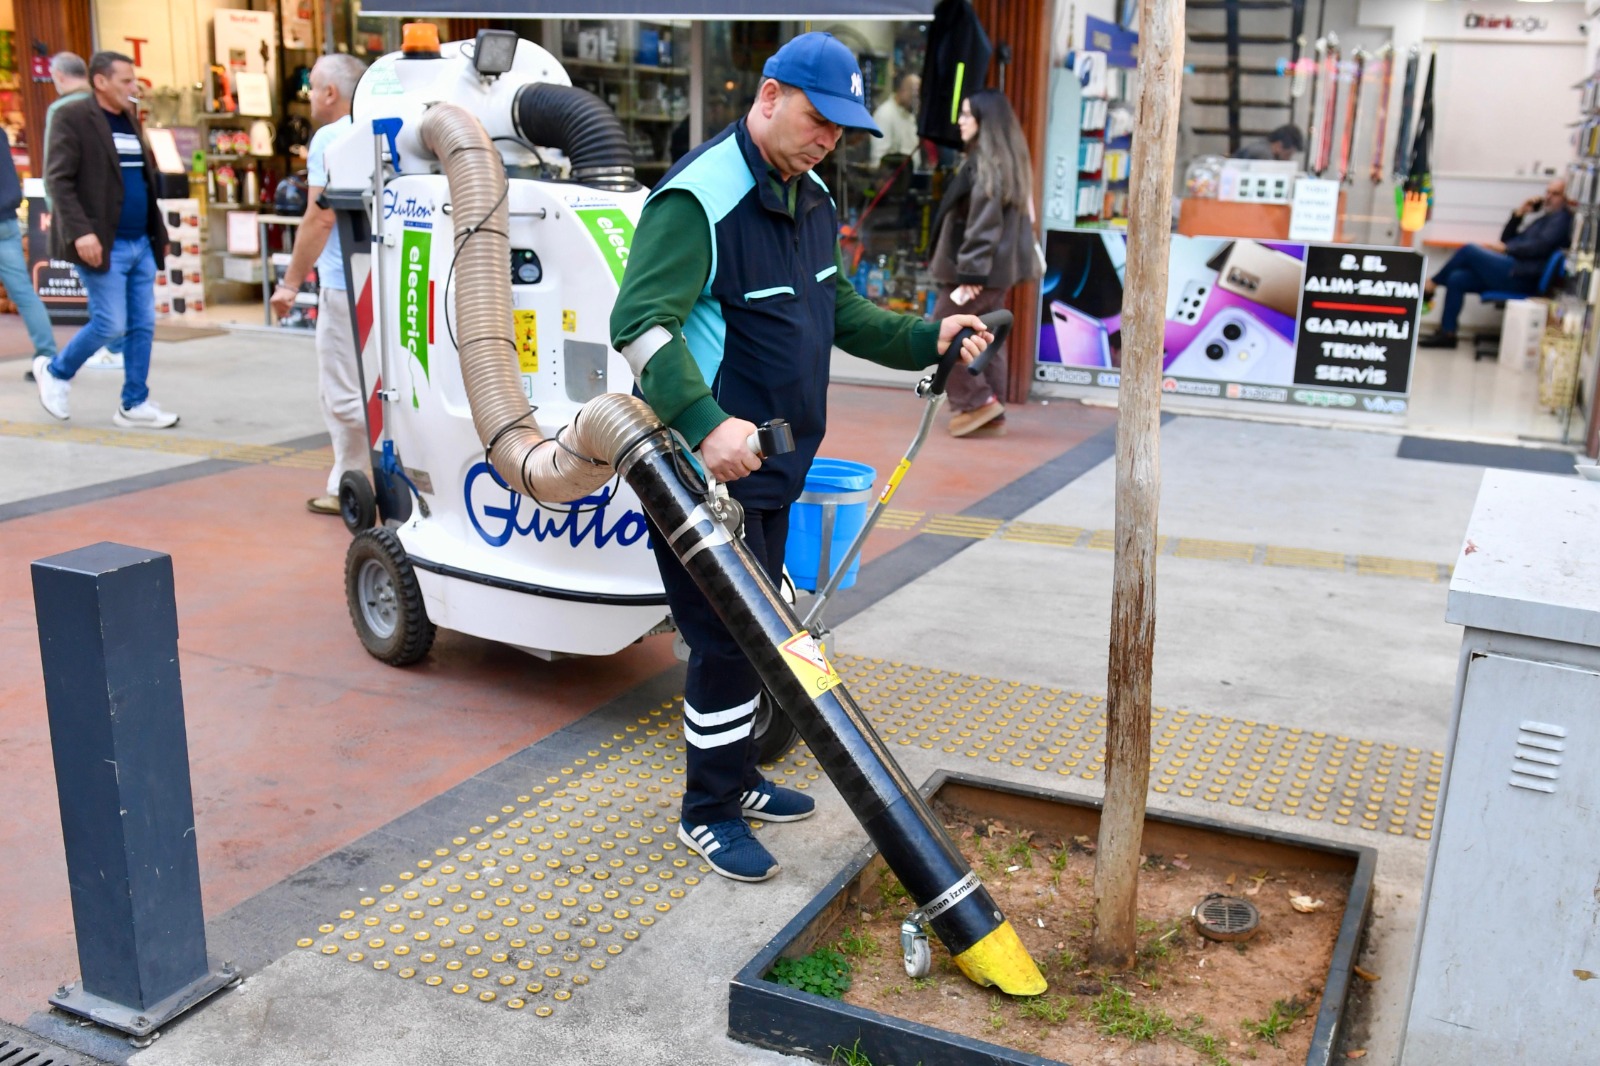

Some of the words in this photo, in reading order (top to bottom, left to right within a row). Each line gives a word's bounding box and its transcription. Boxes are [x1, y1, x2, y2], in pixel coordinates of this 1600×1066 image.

[597, 216, 630, 269] elec
[1340, 254, 1360, 271] 2.
[1362, 255, 1387, 272] EL
[1305, 276, 1419, 299] ALIM-SATIM
[406, 246, 422, 353] electric
[1305, 317, 1409, 340] GARANTİLİ
[1321, 341, 1387, 362] TEKNİK
[1315, 364, 1387, 385] SERVİS
[464, 462, 655, 549] Glutto
